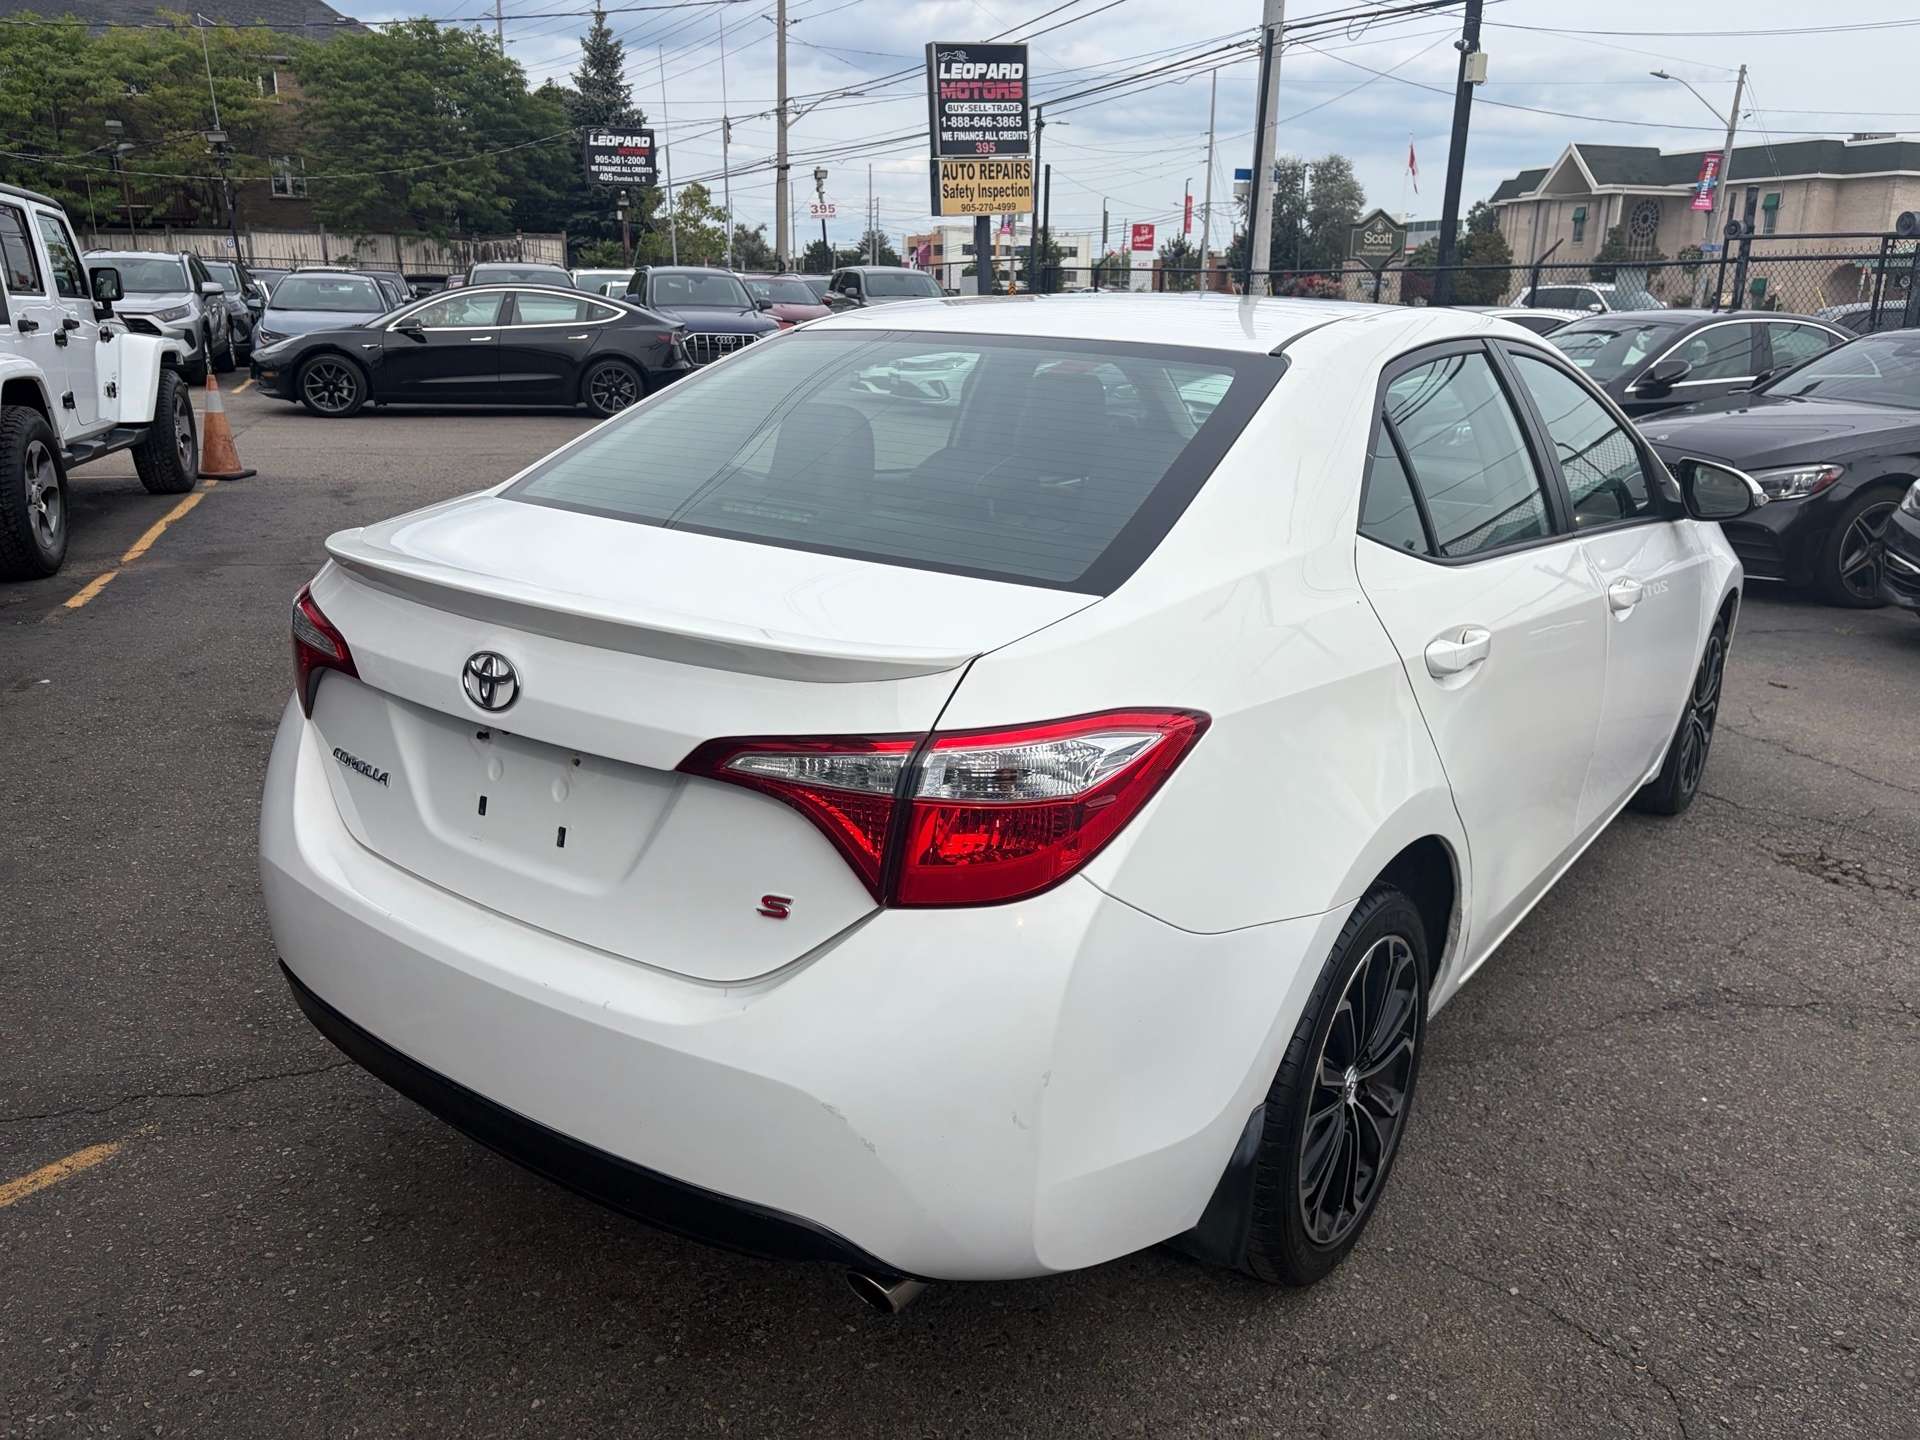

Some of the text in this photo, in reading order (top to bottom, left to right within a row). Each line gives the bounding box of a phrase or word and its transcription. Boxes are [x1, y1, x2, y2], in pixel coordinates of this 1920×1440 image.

[939, 63, 1024, 79] LEOPARD
[941, 81, 1023, 99] MOTORS
[947, 104, 1020, 112] BUY-SELL-TRADE
[941, 116, 1022, 128] 1-888-646-3865
[589, 135, 650, 147] LEOPARD
[942, 131, 1028, 140] WE FINANCE ALL CREDITS
[975, 142, 996, 153] 395
[594, 155, 646, 165] 905-361-2000
[599, 173, 613, 181] 405
[942, 163, 1031, 180] AUTO REPAIRS
[942, 183, 1030, 202] Safety Inspection
[811, 204, 836, 214] 395
[961, 202, 1016, 212] 905-270-4999
[1364, 231, 1393, 244] Scott
[333, 747, 391, 787] COROLLA
[756, 894, 794, 920] S
